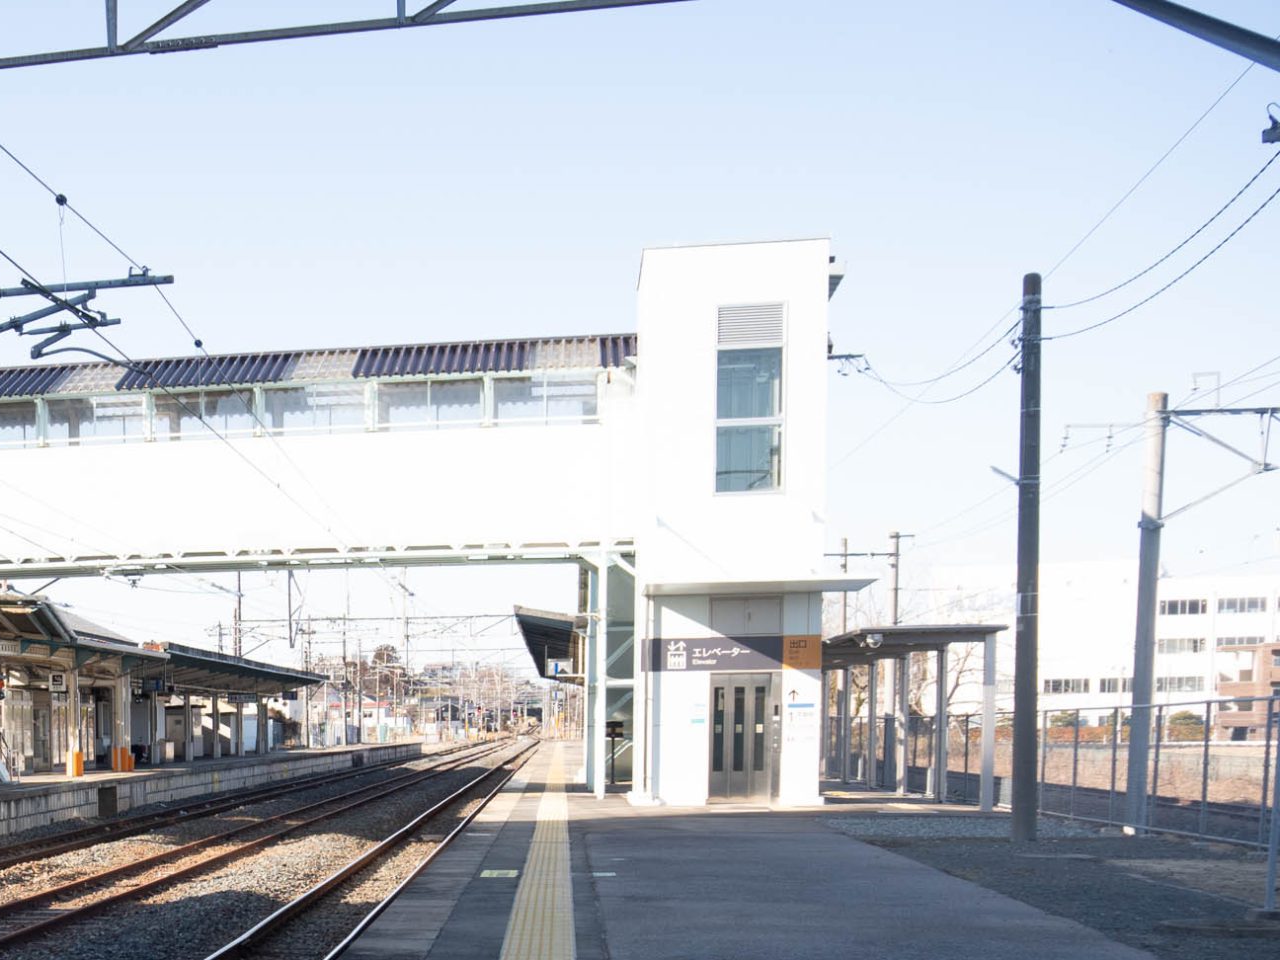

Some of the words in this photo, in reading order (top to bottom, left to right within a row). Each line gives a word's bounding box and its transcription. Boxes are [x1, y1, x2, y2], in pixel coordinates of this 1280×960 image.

[789, 639, 807, 649] 出口
[692, 647, 751, 658] エレベーター
